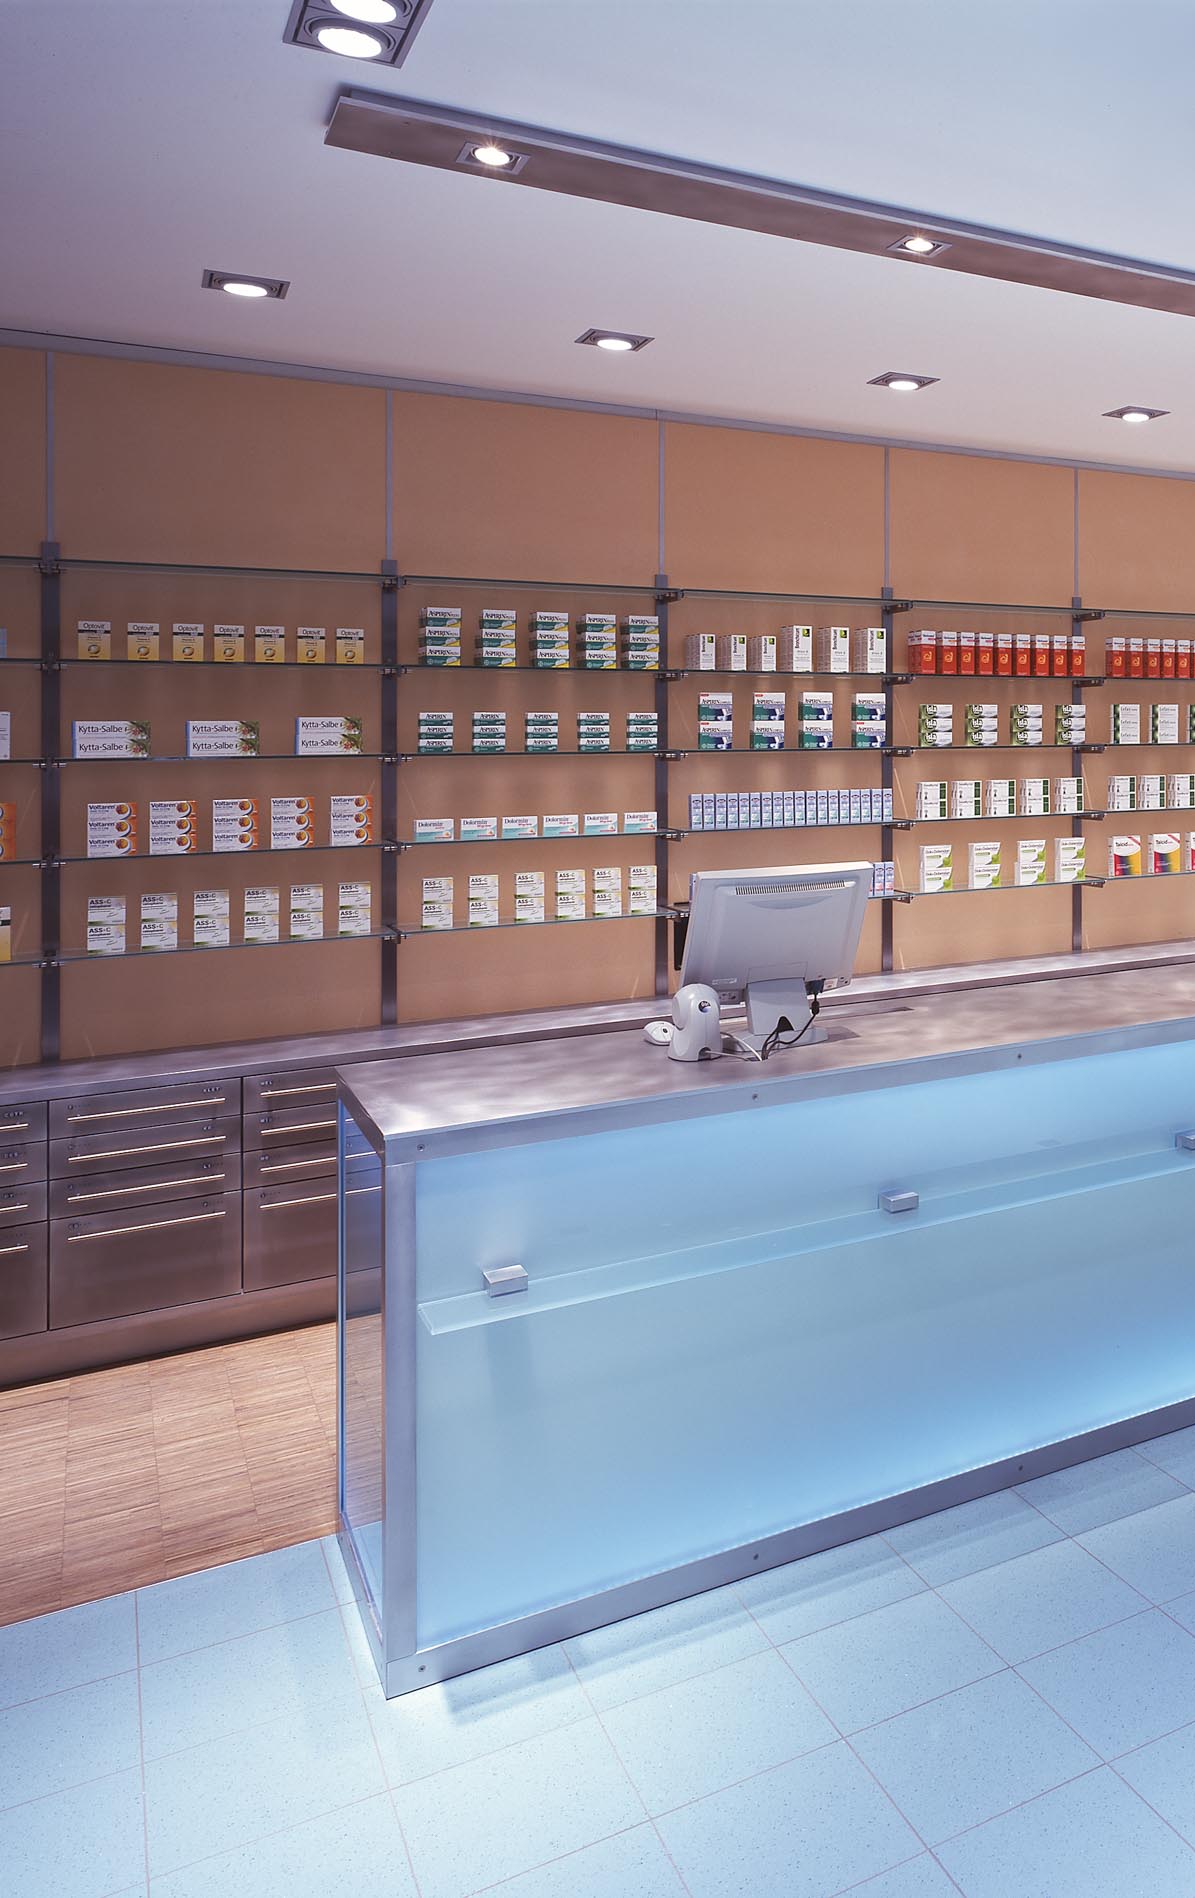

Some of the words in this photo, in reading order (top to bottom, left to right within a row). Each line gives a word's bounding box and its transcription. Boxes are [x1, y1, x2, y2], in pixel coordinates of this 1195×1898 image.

[83, 622, 105, 630] Optovit
[178, 625, 199, 633] Optovit
[302, 721, 338, 729] Kytta-Salbe
[79, 725, 122, 734] Kytta-Salbe
[192, 725, 233, 734] Kytta-Salbe
[79, 743, 123, 752] Kytta-Salbe
[192, 742, 233, 751] Kytta-Salbe
[302, 740, 338, 748] Kytta-Salbe
